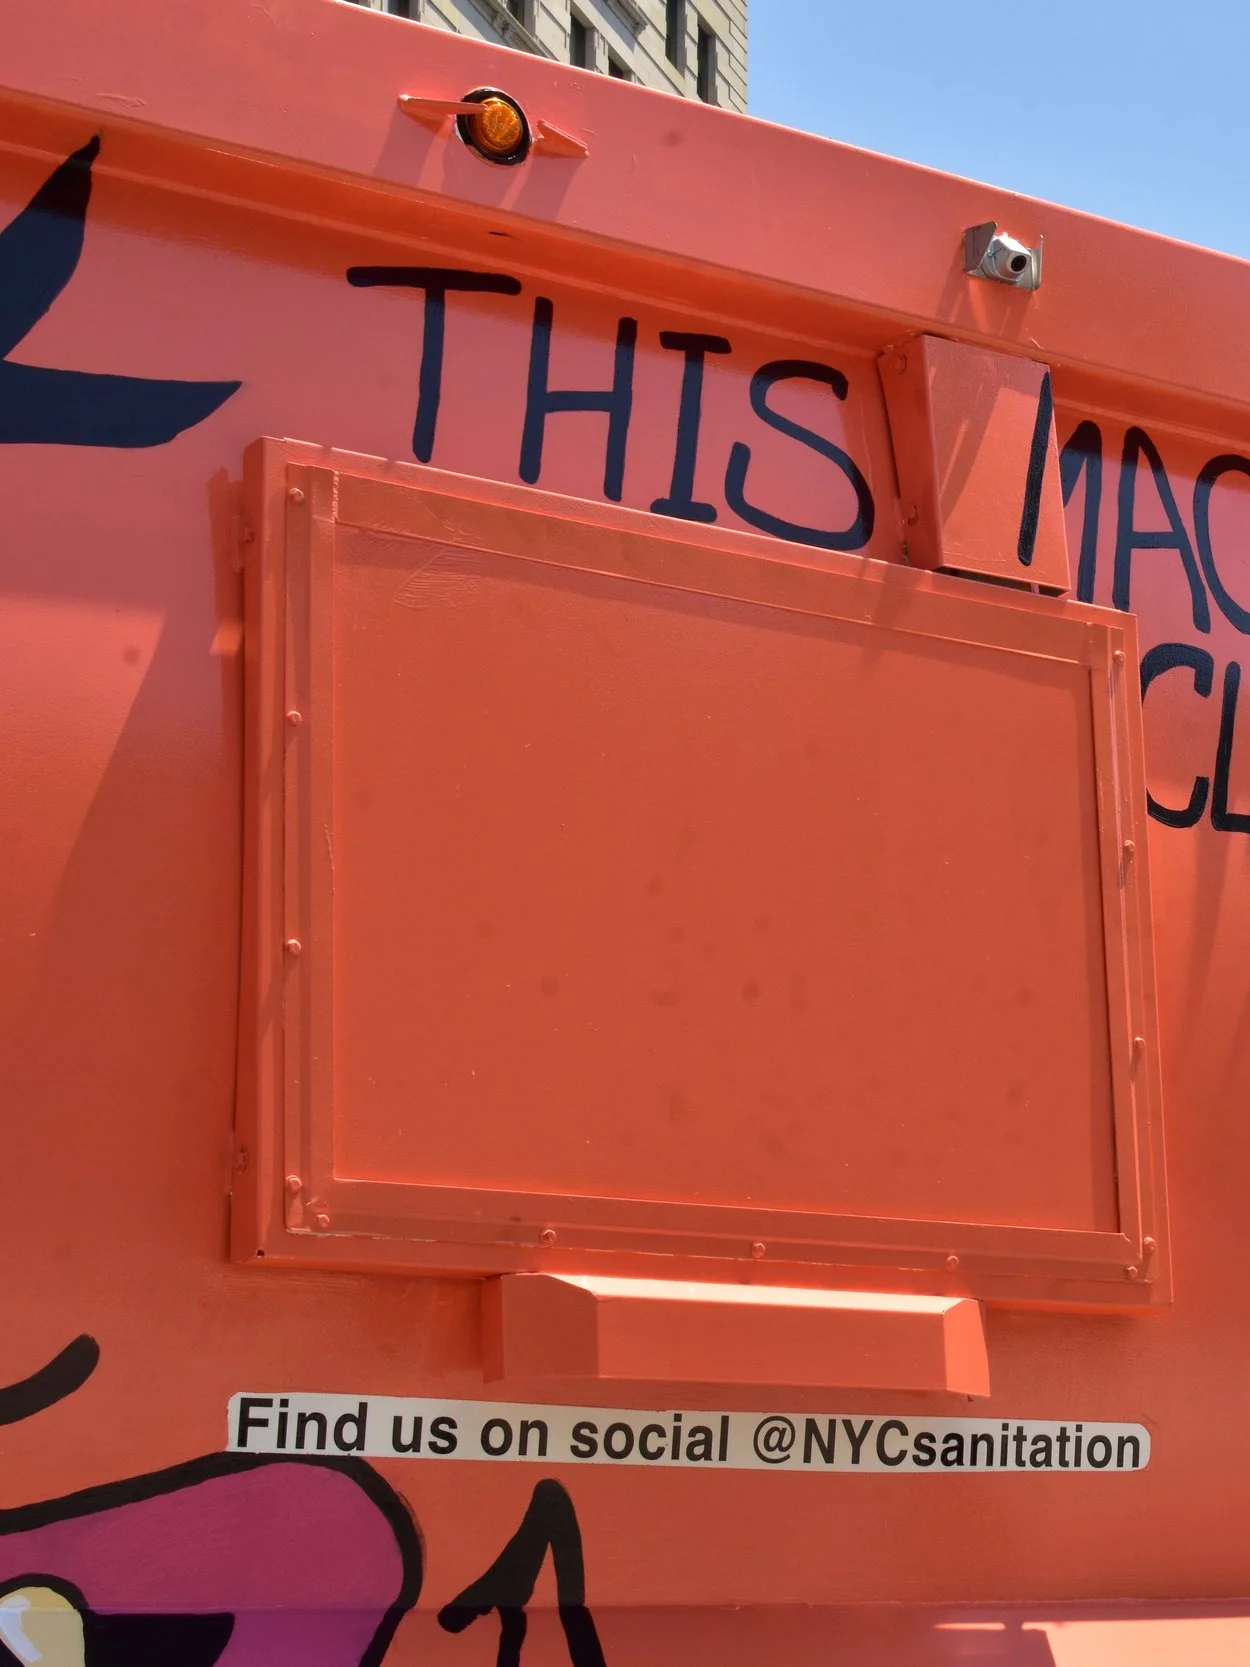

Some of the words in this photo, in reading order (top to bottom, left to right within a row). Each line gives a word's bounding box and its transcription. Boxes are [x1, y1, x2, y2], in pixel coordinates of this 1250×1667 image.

[346, 266, 875, 550] THIS
[236, 1397, 369, 1452] Find
[391, 1415, 459, 1455] us
[480, 1417, 549, 1457] on
[569, 1412, 730, 1461] social
[753, 1414, 1141, 1469] @NYCsanitation
